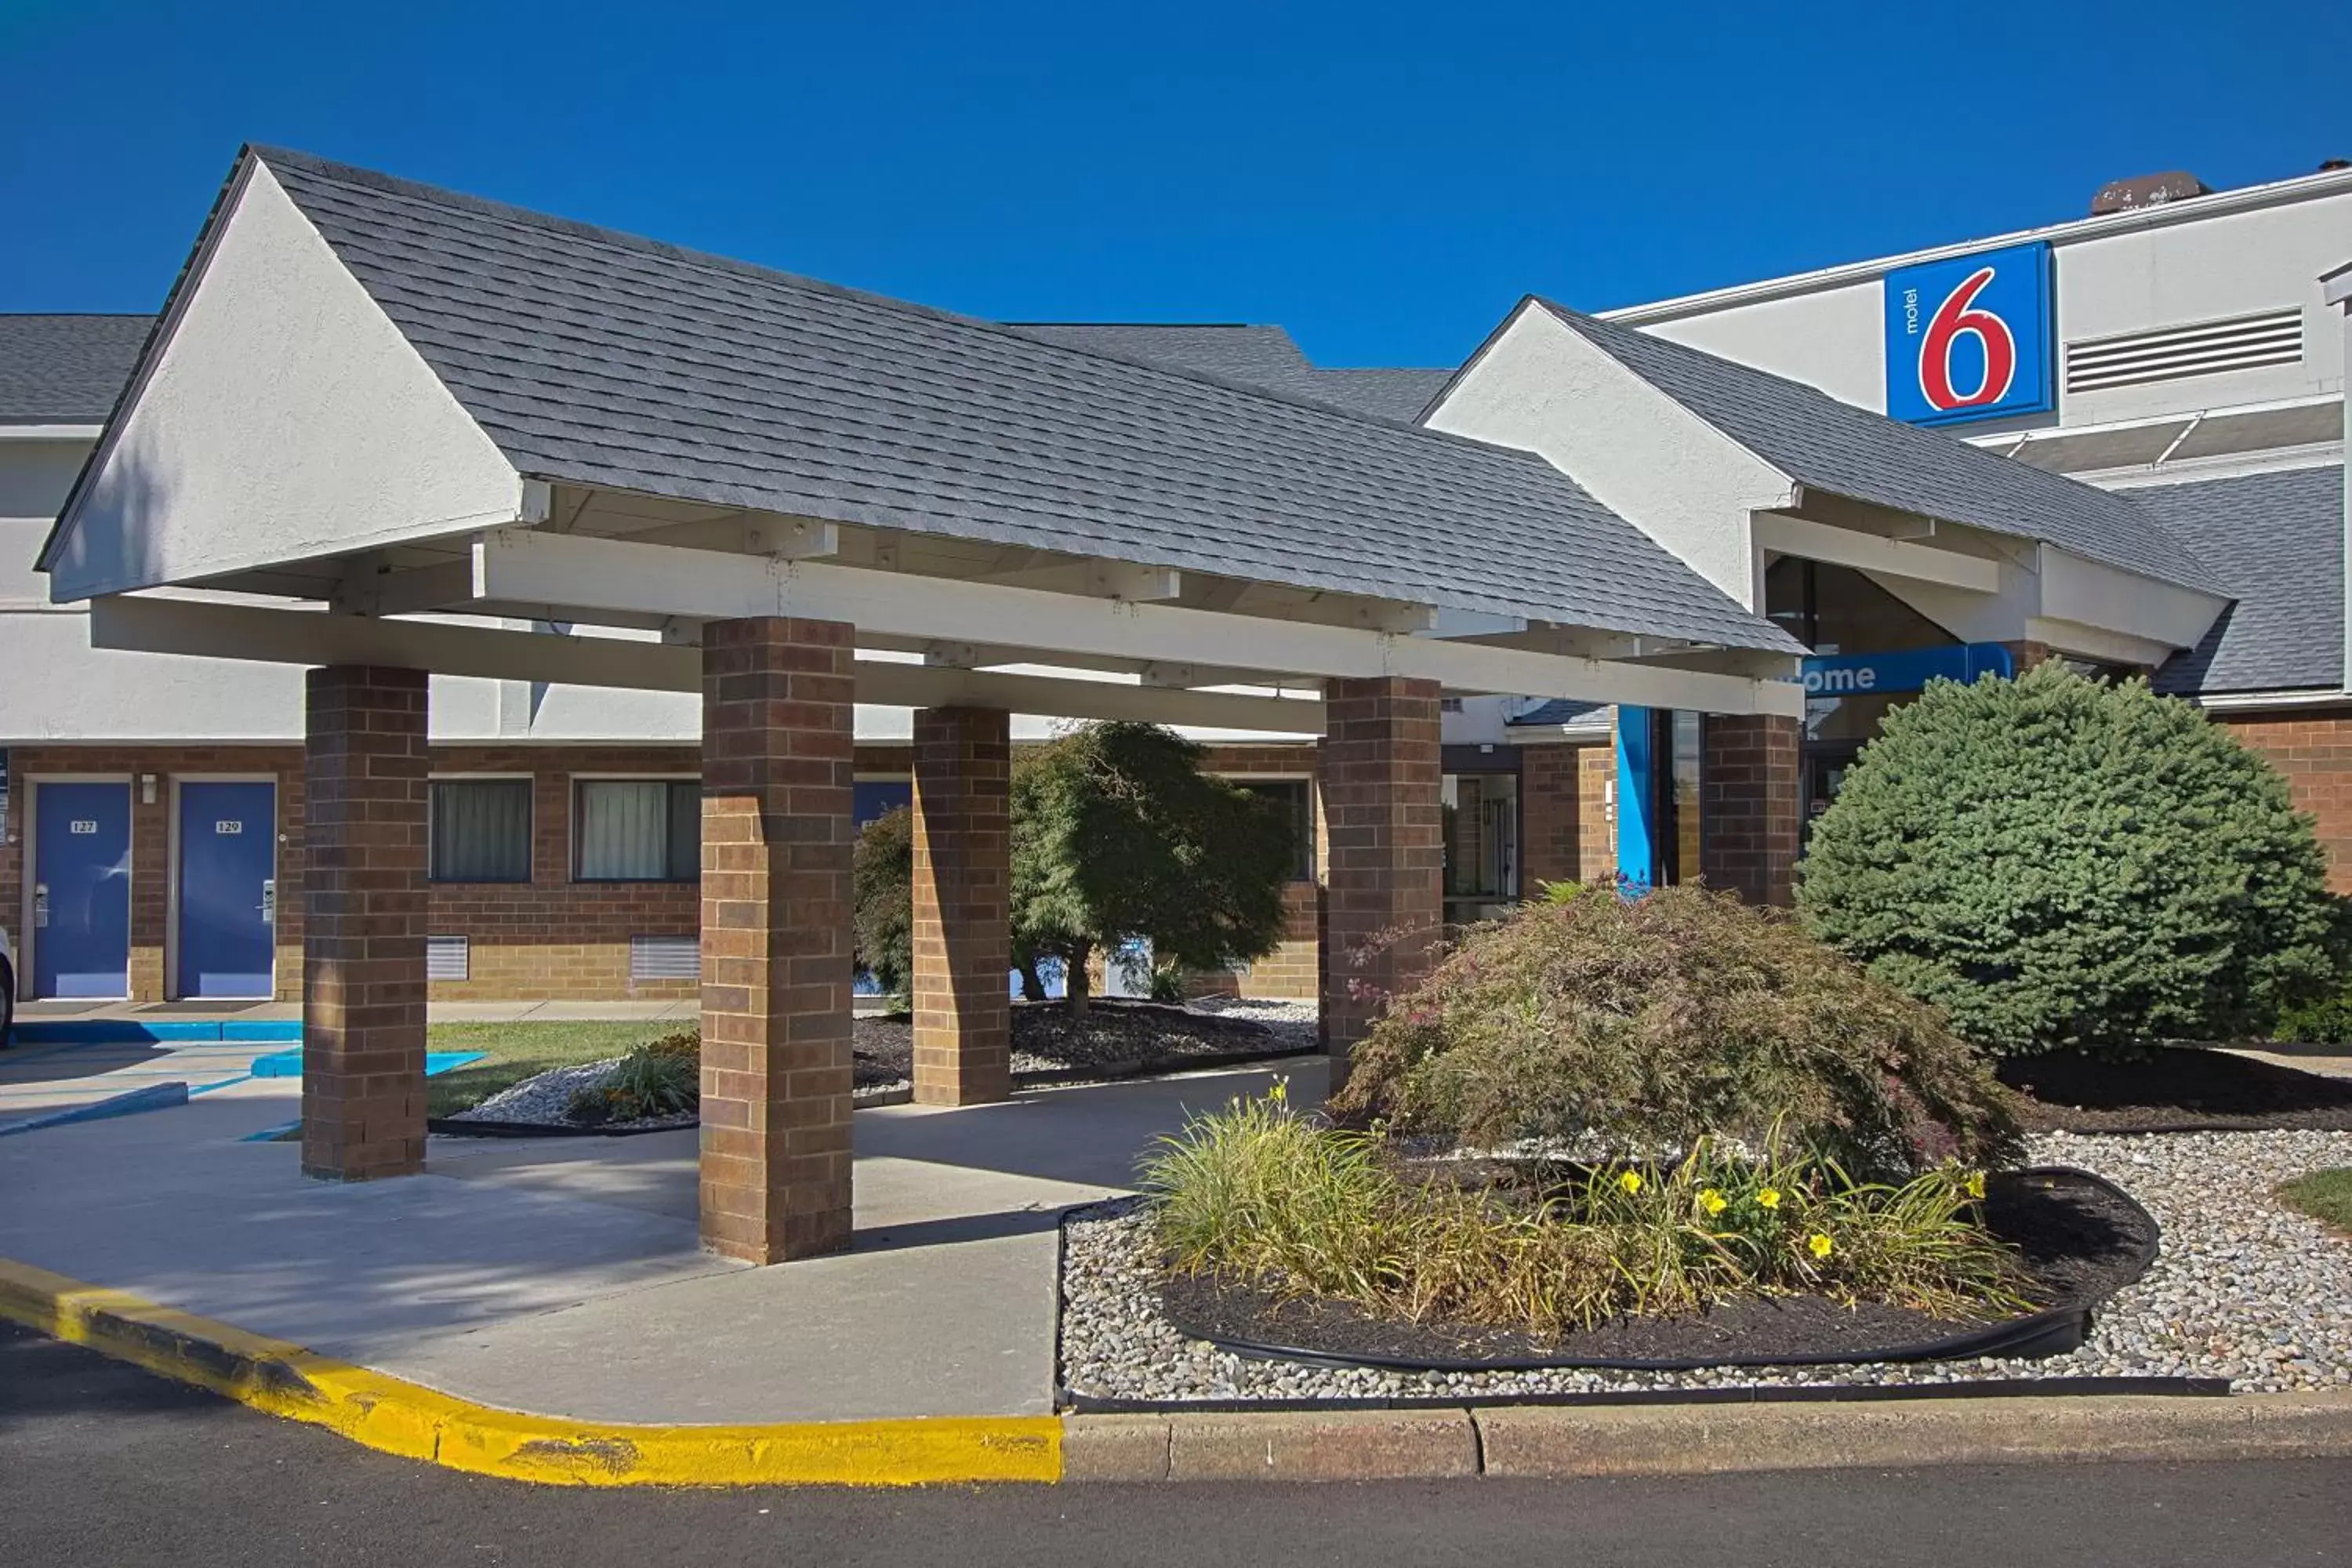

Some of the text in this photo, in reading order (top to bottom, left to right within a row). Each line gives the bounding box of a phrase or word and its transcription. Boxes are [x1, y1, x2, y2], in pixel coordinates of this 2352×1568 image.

[1903, 288, 1918, 335] motel
[1918, 267, 2016, 411] 6
[1804, 667, 1876, 691] ome
